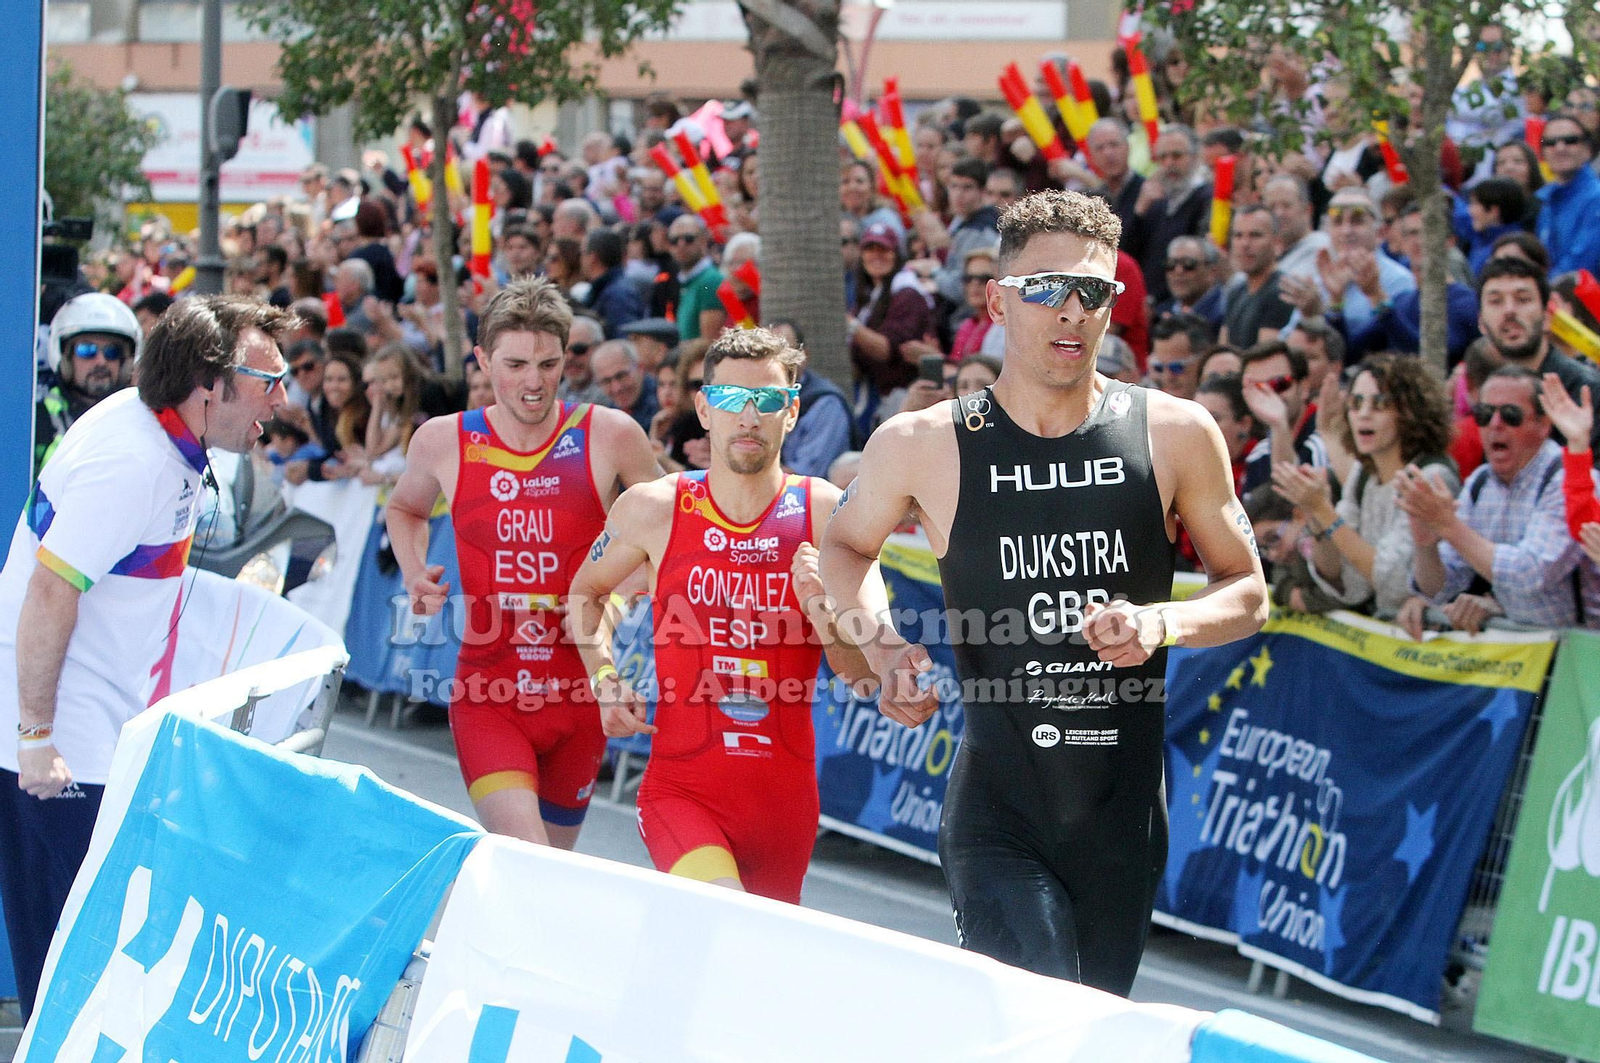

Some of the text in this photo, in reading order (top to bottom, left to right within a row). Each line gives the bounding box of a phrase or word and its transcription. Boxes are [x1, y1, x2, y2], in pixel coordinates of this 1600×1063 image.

[523, 476, 560, 488] LaLiga
[989, 456, 1126, 493] HUUB
[497, 508, 553, 543] GRAU
[729, 550, 779, 565] Sports
[730, 536, 779, 551] LaLiga
[999, 529, 1130, 580] DIJKSTRA
[495, 550, 559, 584] ESP
[687, 566, 790, 613] GONZALEZ
[709, 617, 768, 650] ESP
[717, 661, 736, 671] TM
[1035, 731, 1057, 741] LRS
[1220, 707, 1332, 784] European
[891, 781, 943, 833] Unio
[1258, 880, 1326, 952] Union
